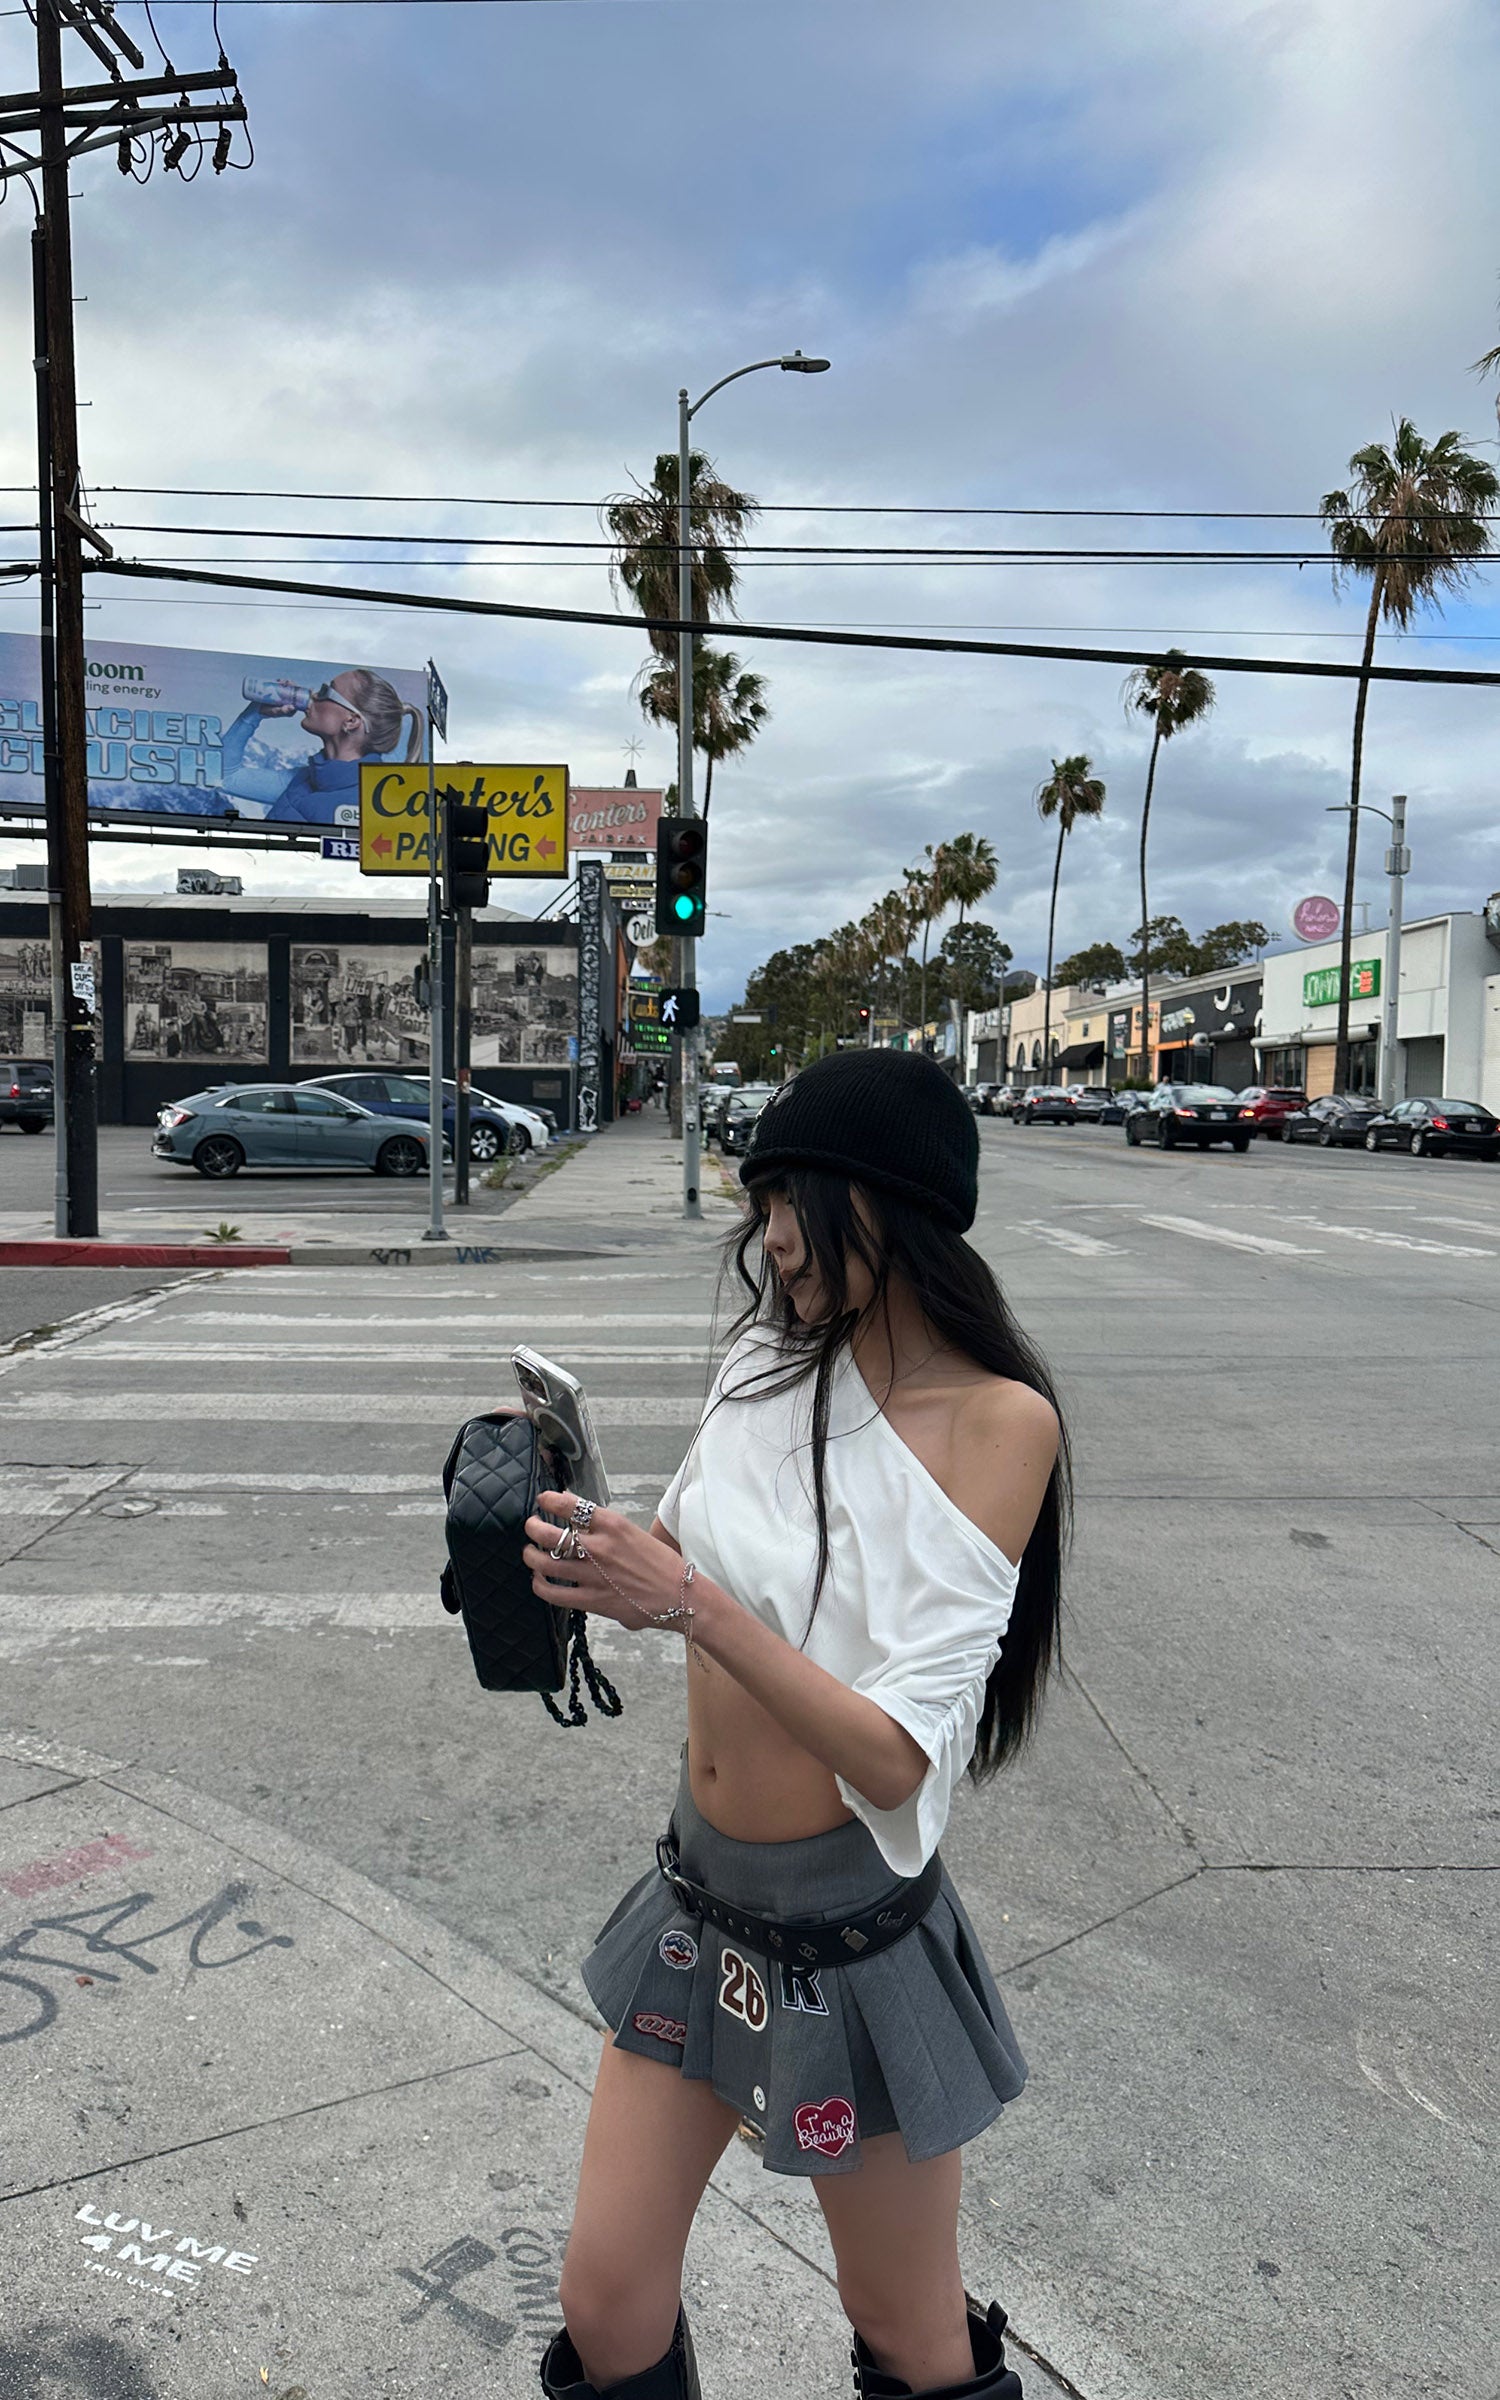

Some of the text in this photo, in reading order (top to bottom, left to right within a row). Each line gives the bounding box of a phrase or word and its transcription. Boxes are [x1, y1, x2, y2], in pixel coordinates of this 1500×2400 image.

[83, 658, 144, 681] loom
[86, 681, 161, 698] ling energy
[0, 698, 224, 747] GLCIER
[0, 734, 224, 787] CUSH
[372, 774, 555, 818] Cater's
[569, 793, 647, 833] anters
[396, 832, 531, 861] PANG
[579, 834, 646, 844] FAIRFAX
[719, 1948, 768, 2031] 26
[778, 1961, 829, 2016] R
[799, 2124, 855, 2149] Beauty
[841, 2114, 854, 2126] a
[74, 2204, 259, 2275] LUV ME
[80, 2235, 113, 2253] 4
